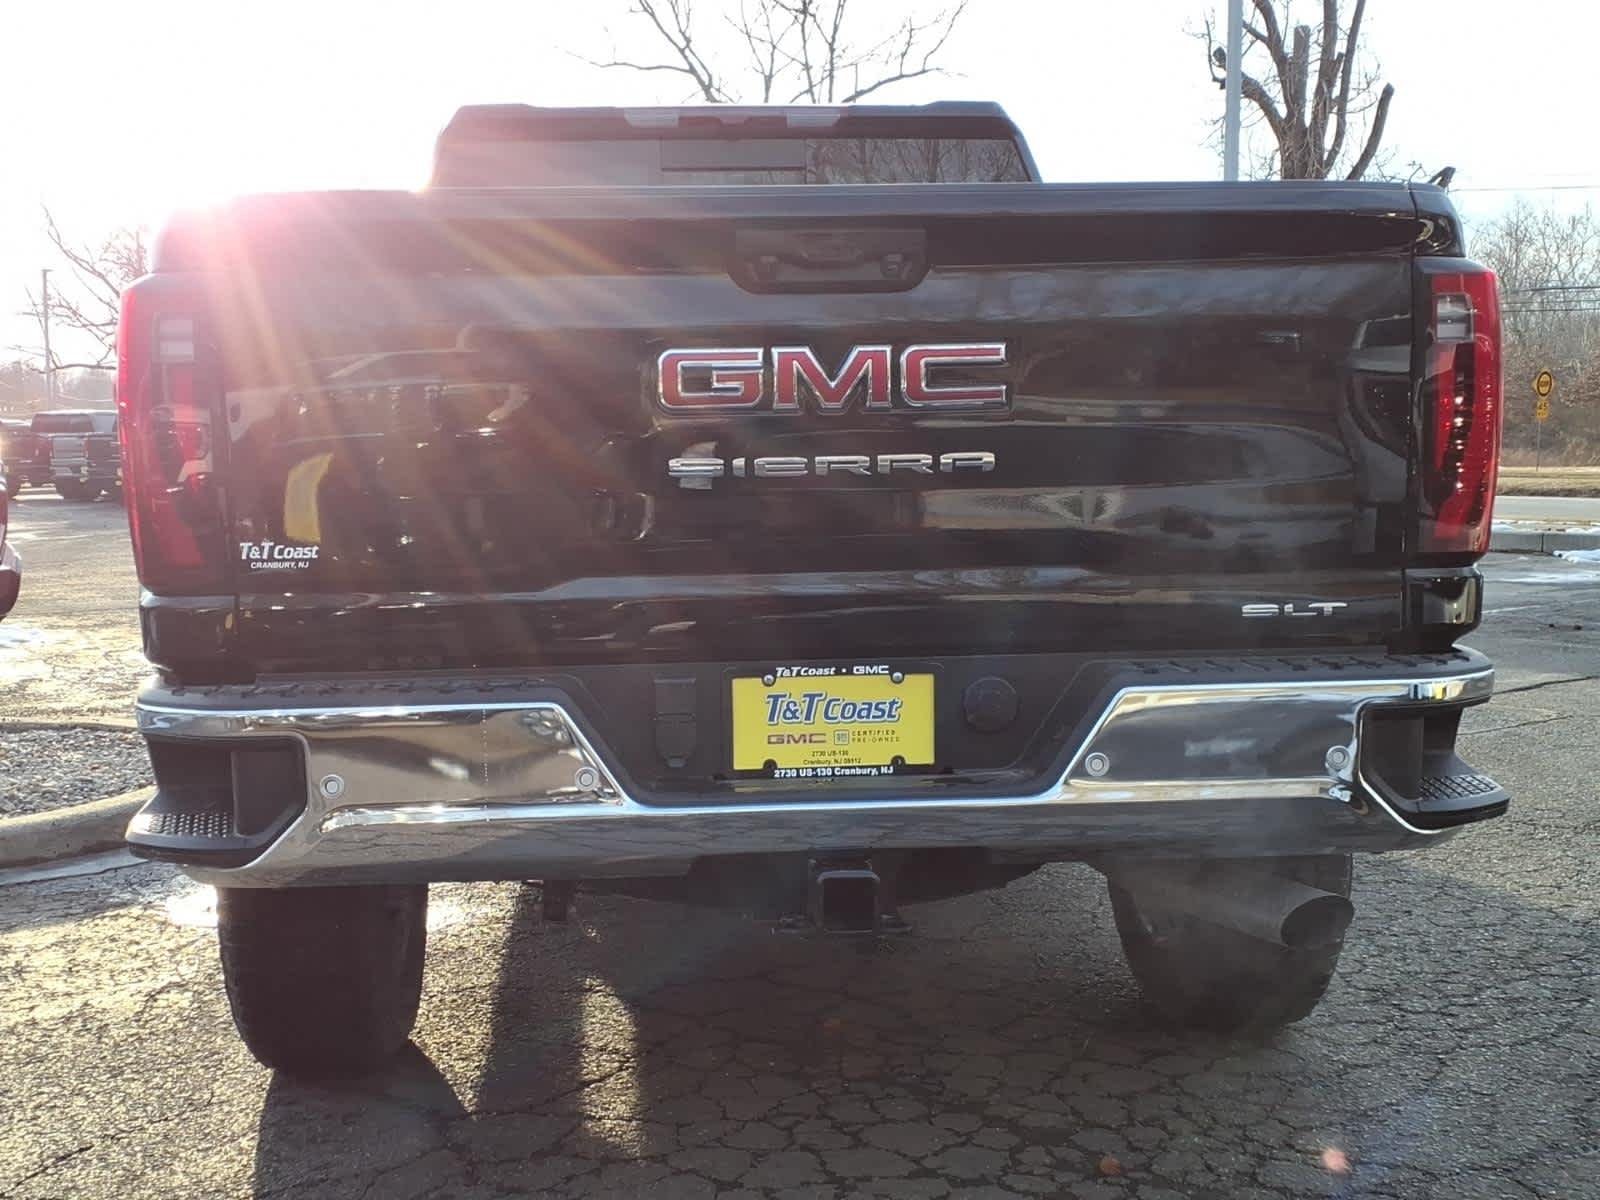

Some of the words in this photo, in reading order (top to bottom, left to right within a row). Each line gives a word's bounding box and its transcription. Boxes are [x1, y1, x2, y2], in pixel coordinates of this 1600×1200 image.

[657, 343, 1007, 409] GMC
[667, 451, 996, 478] SIERRA
[239, 541, 275, 560] T&T
[273, 545, 320, 559] Coast
[250, 561, 297, 569] CRANBURY,
[297, 561, 310, 569] NJ
[1241, 602, 1348, 617] SLT
[800, 667, 836, 676] Coast
[853, 665, 890, 675] GMC
[766, 692, 826, 725] T&T
[822, 697, 902, 722] Coast
[767, 733, 827, 745] GMC
[851, 729, 896, 737] CERTIFIED
[811, 750, 826, 758] 2730
[774, 769, 797, 778] 2730
[799, 767, 833, 777] US-130
[834, 766, 879, 777] Cranbury,
[880, 765, 895, 775] NJ
